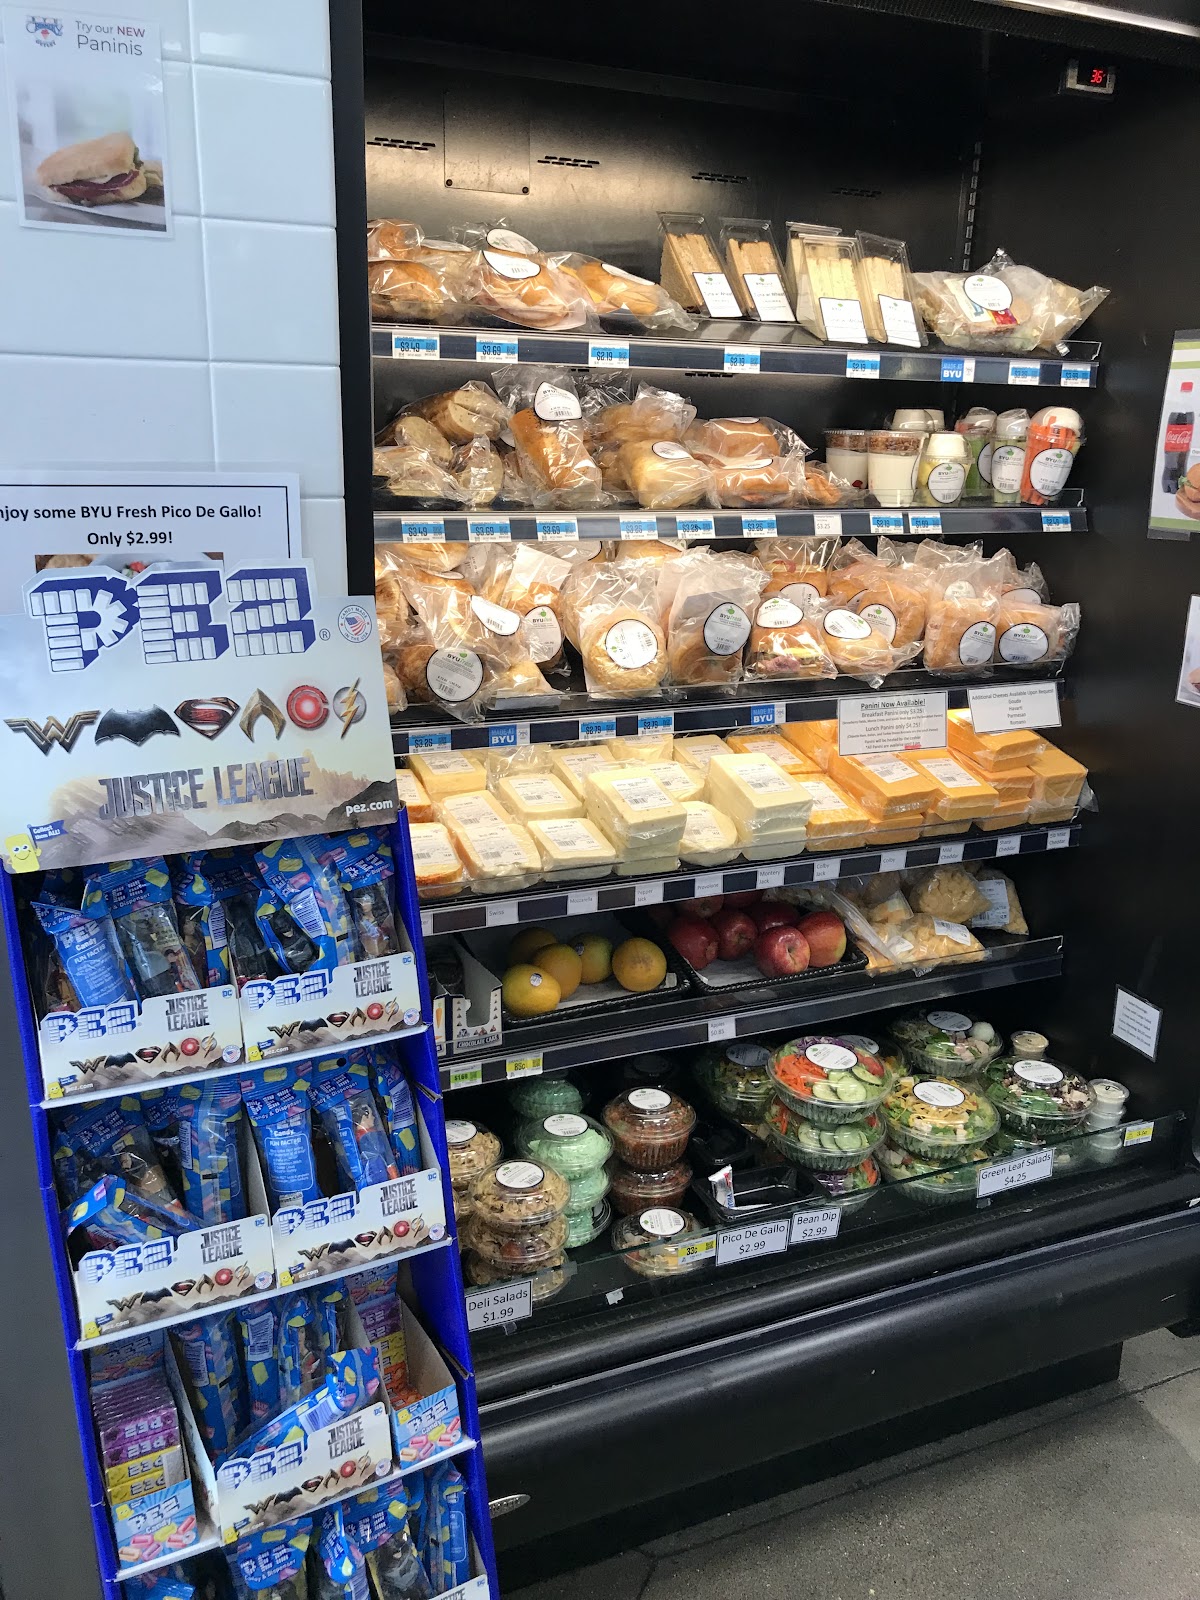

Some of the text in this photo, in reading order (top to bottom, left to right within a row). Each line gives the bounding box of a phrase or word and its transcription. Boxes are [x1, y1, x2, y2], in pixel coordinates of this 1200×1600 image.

[76, 20, 145, 37] Try our NEW
[77, 34, 142, 56] Paninis
[400, 341, 420, 353] $3.49
[482, 344, 501, 356] $3.69
[596, 351, 613, 361] $2.19
[943, 370, 962, 378] BYU
[34, 508, 76, 518] some
[81, 507, 112, 518] BYU
[117, 506, 157, 518] Fresh
[162, 506, 191, 518] Pico
[196, 506, 215, 518] De
[219, 505, 262, 518] Gallo!
[816, 522, 831, 530] $3.25
[87, 531, 173, 547] Only $2.99!
[29, 567, 316, 673] PEZ
[861, 701, 880, 710] Panini
[897, 699, 926, 707] Available!
[753, 714, 773, 723] BYU
[862, 710, 884, 718] Breakfast
[491, 733, 515, 746] BYU
[98, 757, 317, 820] JUSTICE LEAGUE
[345, 799, 393, 817] pez.com
[33, 825, 53, 834] Collect
[882, 857, 896, 866] Colby
[940, 852, 959, 861] Cheddar
[816, 862, 830, 871] Colby
[816, 870, 826, 878] Jack
[759, 877, 770, 885] Jack
[637, 889, 654, 897] Pepper
[489, 908, 505, 917] Swiss
[60, 921, 100, 949] PEZ
[76, 937, 97, 951] Candy
[402, 956, 412, 965] DC
[353, 961, 391, 983] JUSTICE
[222, 988, 233, 998] DC
[245, 972, 328, 1010] PEZ
[355, 976, 393, 998] LEAGUE
[165, 993, 209, 1016] JUSTICE
[46, 1004, 136, 1044] PEZ
[167, 1011, 210, 1032] LEAGUE
[274, 1129, 295, 1137] Candy
[981, 1153, 1051, 1180] Green Leaf Salads
[428, 1172, 437, 1181] DC
[1004, 1172, 1027, 1186] $4.25
[380, 1178, 416, 1201] JUSTICE
[382, 1195, 418, 1217] LEAGUE
[255, 1217, 265, 1227] DC
[276, 1195, 355, 1237] PEZ
[797, 1212, 837, 1226] Bean Dip
[200, 1224, 241, 1249] JUSTICE
[722, 1224, 786, 1244] Pico De Gallo
[802, 1226, 828, 1239] $2.99
[203, 1243, 243, 1264] LEAGUE
[739, 1240, 766, 1255] $2.99
[83, 1240, 173, 1284] PEZ
[468, 1289, 528, 1312] Deli Salads
[483, 1307, 514, 1324] $1.99
[367, 1324, 386, 1340] EZ
[373, 1407, 383, 1416] DC
[407, 1399, 450, 1433] PEZ
[328, 1416, 363, 1445] JUSTICE
[421, 1418, 443, 1435] Candy
[329, 1435, 365, 1459] LEAGUE
[222, 1442, 303, 1489] PEZ
[127, 1495, 180, 1532] PEZ
[146, 1517, 171, 1533] Candy
